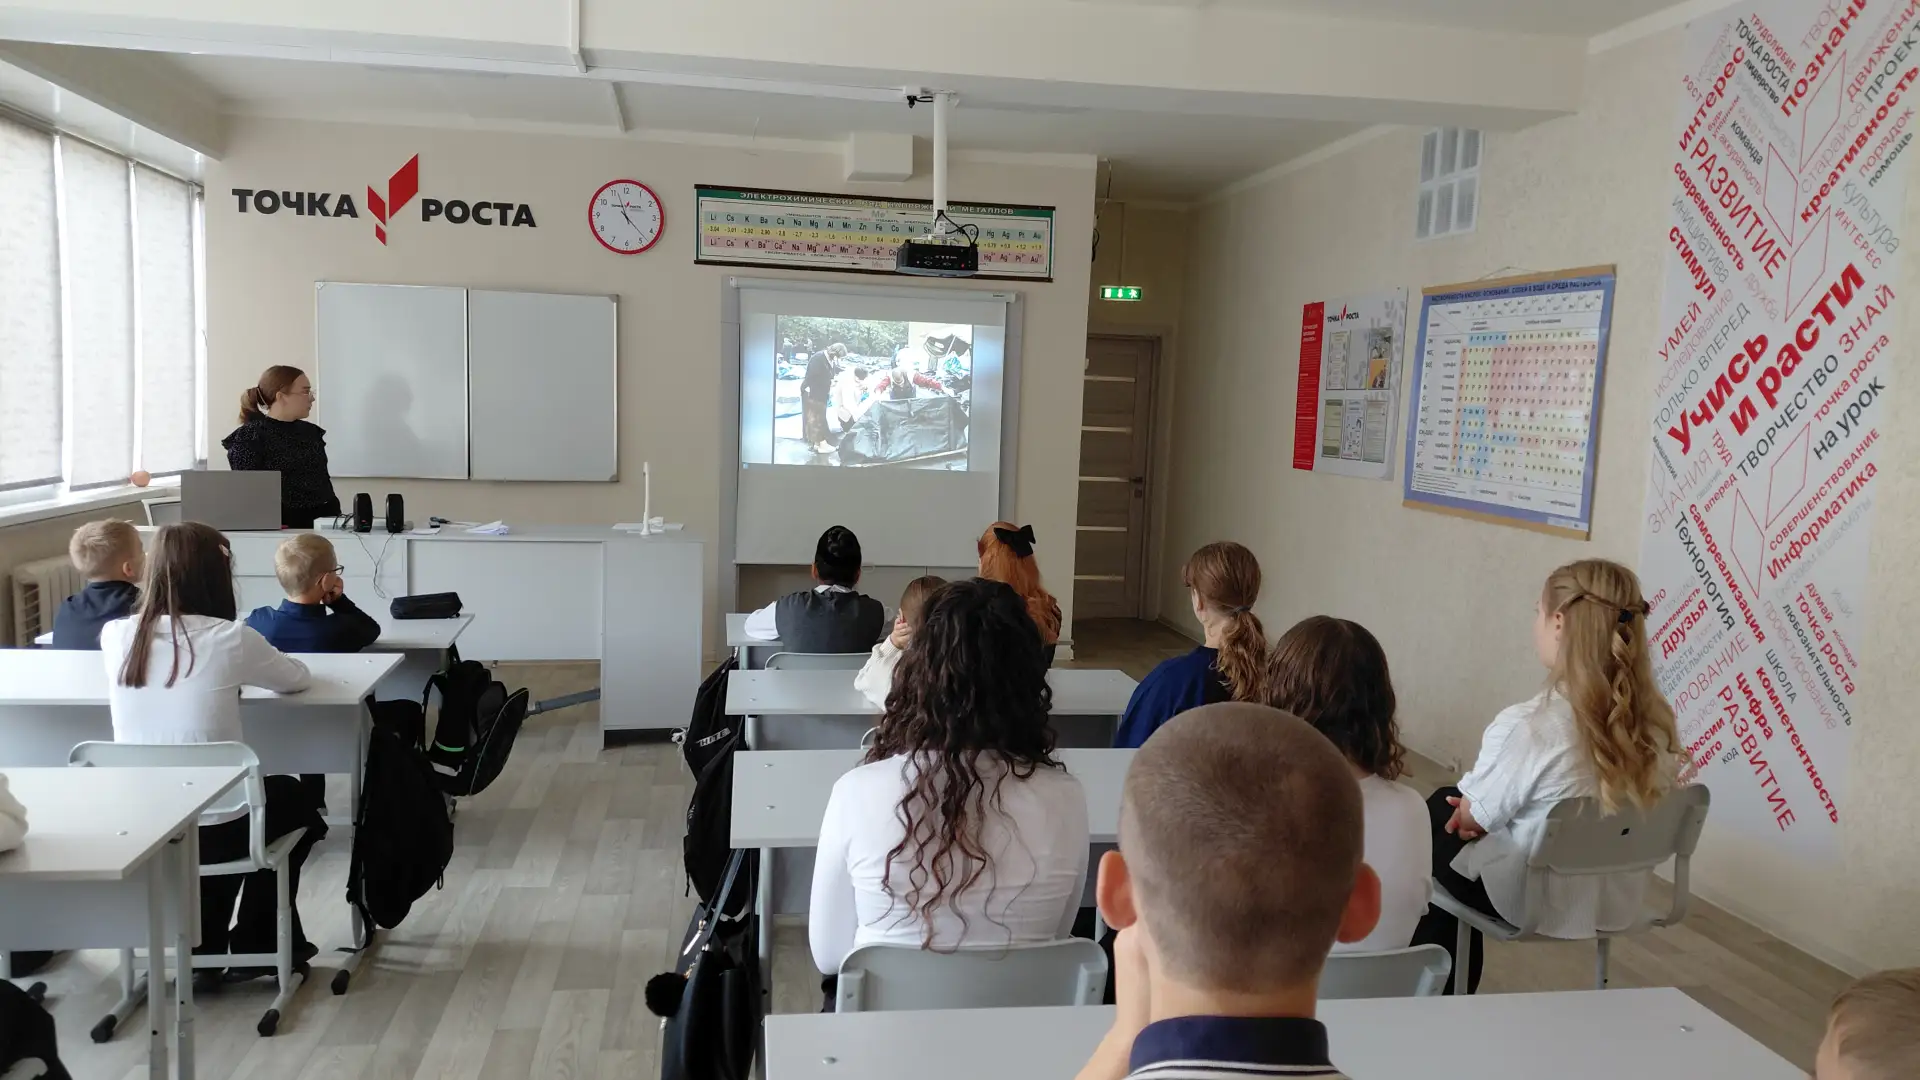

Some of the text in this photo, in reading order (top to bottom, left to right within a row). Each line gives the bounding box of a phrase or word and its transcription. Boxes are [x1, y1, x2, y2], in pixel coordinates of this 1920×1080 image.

[1735, 17, 1763, 59] ТОЧКА
[1760, 52, 1790, 93] РОСТА
[1744, 59, 1780, 104] лидерство
[1751, 13, 1797, 73] ТРУДОЛЮБИЕ
[1679, 46, 1745, 151] интерес
[1730, 120, 1763, 165] команда
[1801, 67, 1919, 223] креативность
[232, 188, 537, 228] ТОЧКА РОСТА
[726, 214, 735, 222] Cs
[809, 220, 819, 229] Mg
[875, 223, 883, 231] Fe
[891, 225, 900, 233] Co
[923, 226, 931, 234] Sn
[740, 192, 855, 206] ЭЛЕКТРОХИМИЧЕСКИЙ
[887, 201, 956, 213] НАПРЯЖЕЙ
[961, 206, 1014, 215] МЕТАЛЛОВ
[1672, 195, 1730, 284] инициатива
[1674, 162, 1744, 271] современность
[1690, 136, 1787, 280] РАЗВИТИЕ
[1834, 207, 1882, 270] ИНТЕРЕС
[1842, 179, 1901, 255] культура
[1669, 226, 1717, 301] стимул
[1658, 301, 1703, 362] УМЕЙ
[1728, 394, 1760, 437] и
[1756, 261, 1867, 412] расти
[1838, 283, 1896, 354] ЗНАЙ
[1653, 301, 1752, 431] ТОЛЬКО ВПЕРЕД
[1667, 333, 1770, 456] Учись
[1813, 334, 1890, 423] точка роста
[1711, 427, 1734, 468] труд
[1736, 354, 1839, 478] ТВОРЧЕСТВО
[1813, 429, 1840, 461] на
[1836, 375, 1887, 439] урок
[1648, 448, 1714, 535] ЗНАНИЯ
[1703, 472, 1739, 513] вперед
[1766, 461, 1879, 581] Информатика
[1768, 427, 1881, 551] СОВЕРШЕНСТВОВАНИЕ
[1674, 511, 1737, 632] Технология
[1688, 503, 1767, 645] самореализация
[1804, 582, 1835, 624] думай
[1647, 587, 1702, 648] стремленность
[1661, 598, 1709, 660] друзья
[1795, 591, 1826, 643] точка
[1820, 642, 1856, 696] роста
[1663, 628, 1725, 698] ЕДЕЯТЕЛЬНОСТИ
[1673, 631, 1751, 720] ИРОВАНИЕ
[1735, 671, 1775, 741] цифра
[1765, 648, 1799, 705] ШКОЛА
[1782, 603, 1852, 727] ЛЮБОЗНАТЕЛЬНОСТЬ
[1717, 684, 1797, 833] РАЗВИТИЕ
[1756, 666, 1840, 824] компетентность
